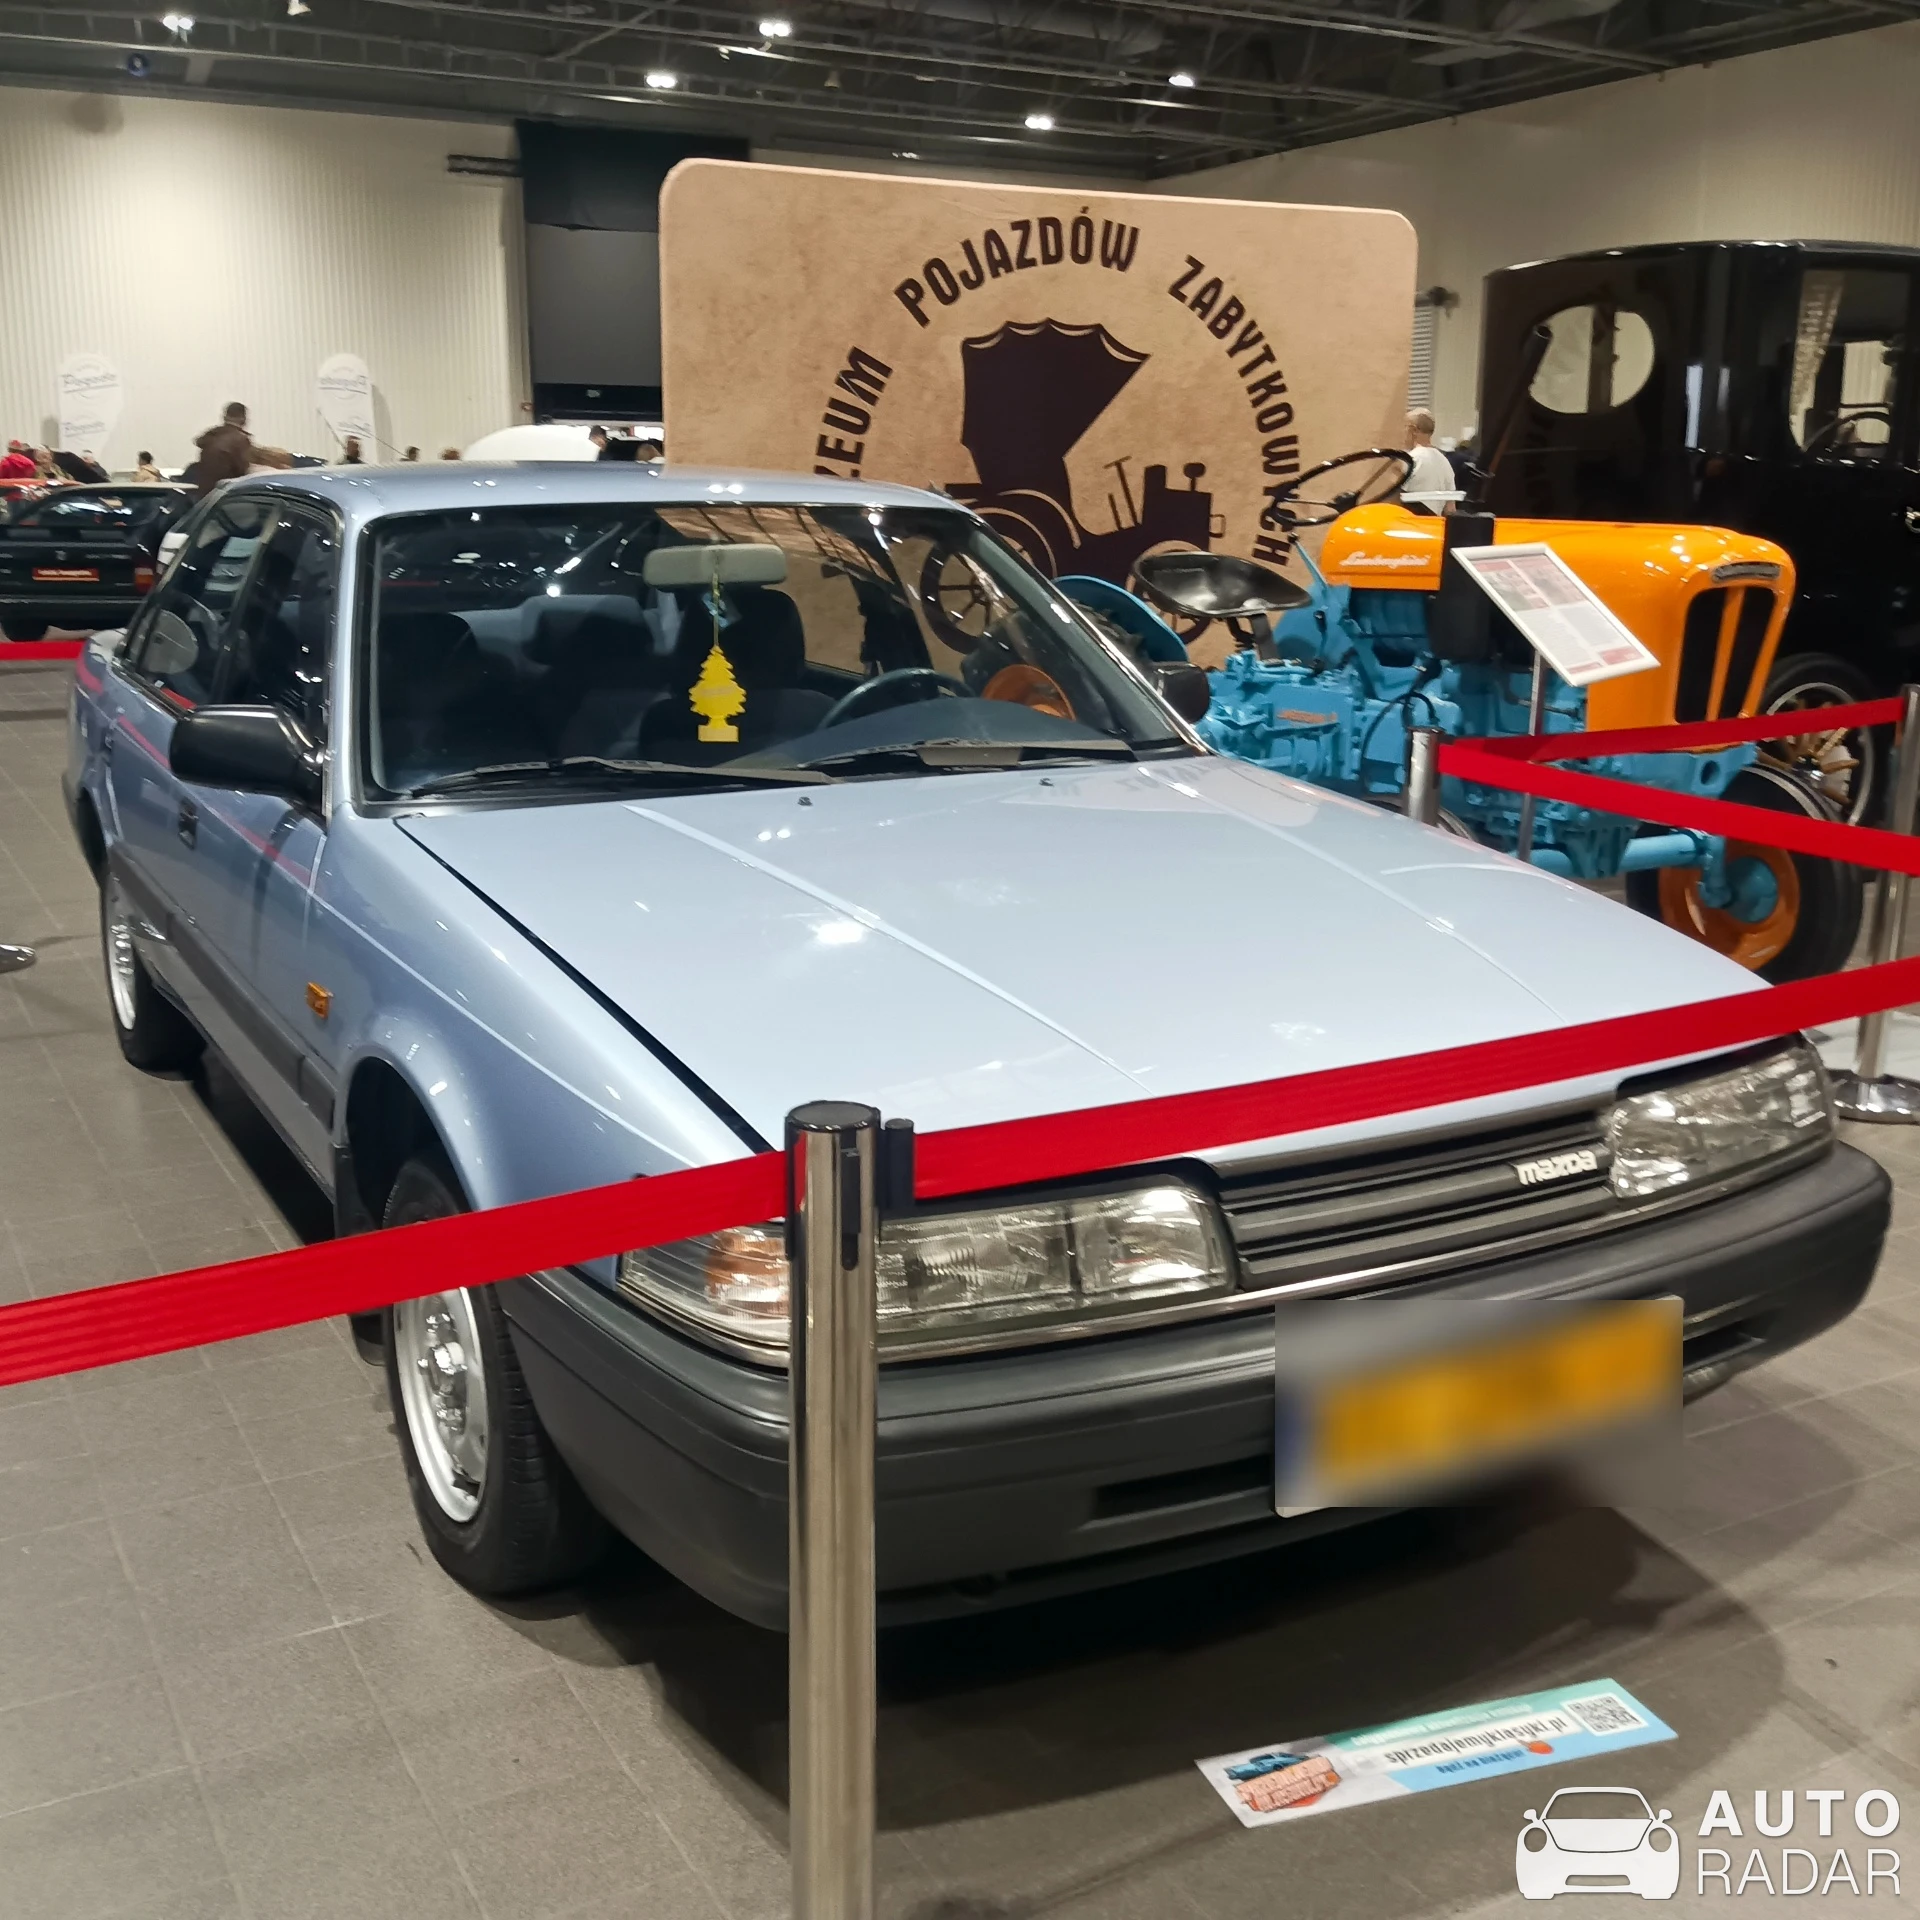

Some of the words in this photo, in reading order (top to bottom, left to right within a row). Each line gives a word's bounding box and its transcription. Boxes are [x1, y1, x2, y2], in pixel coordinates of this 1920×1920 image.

[894, 206, 1141, 328] POJAZDÓW
[1168, 254, 1300, 566] ZABYTKOWYCH
[1517, 1150, 1598, 1185] mazda
